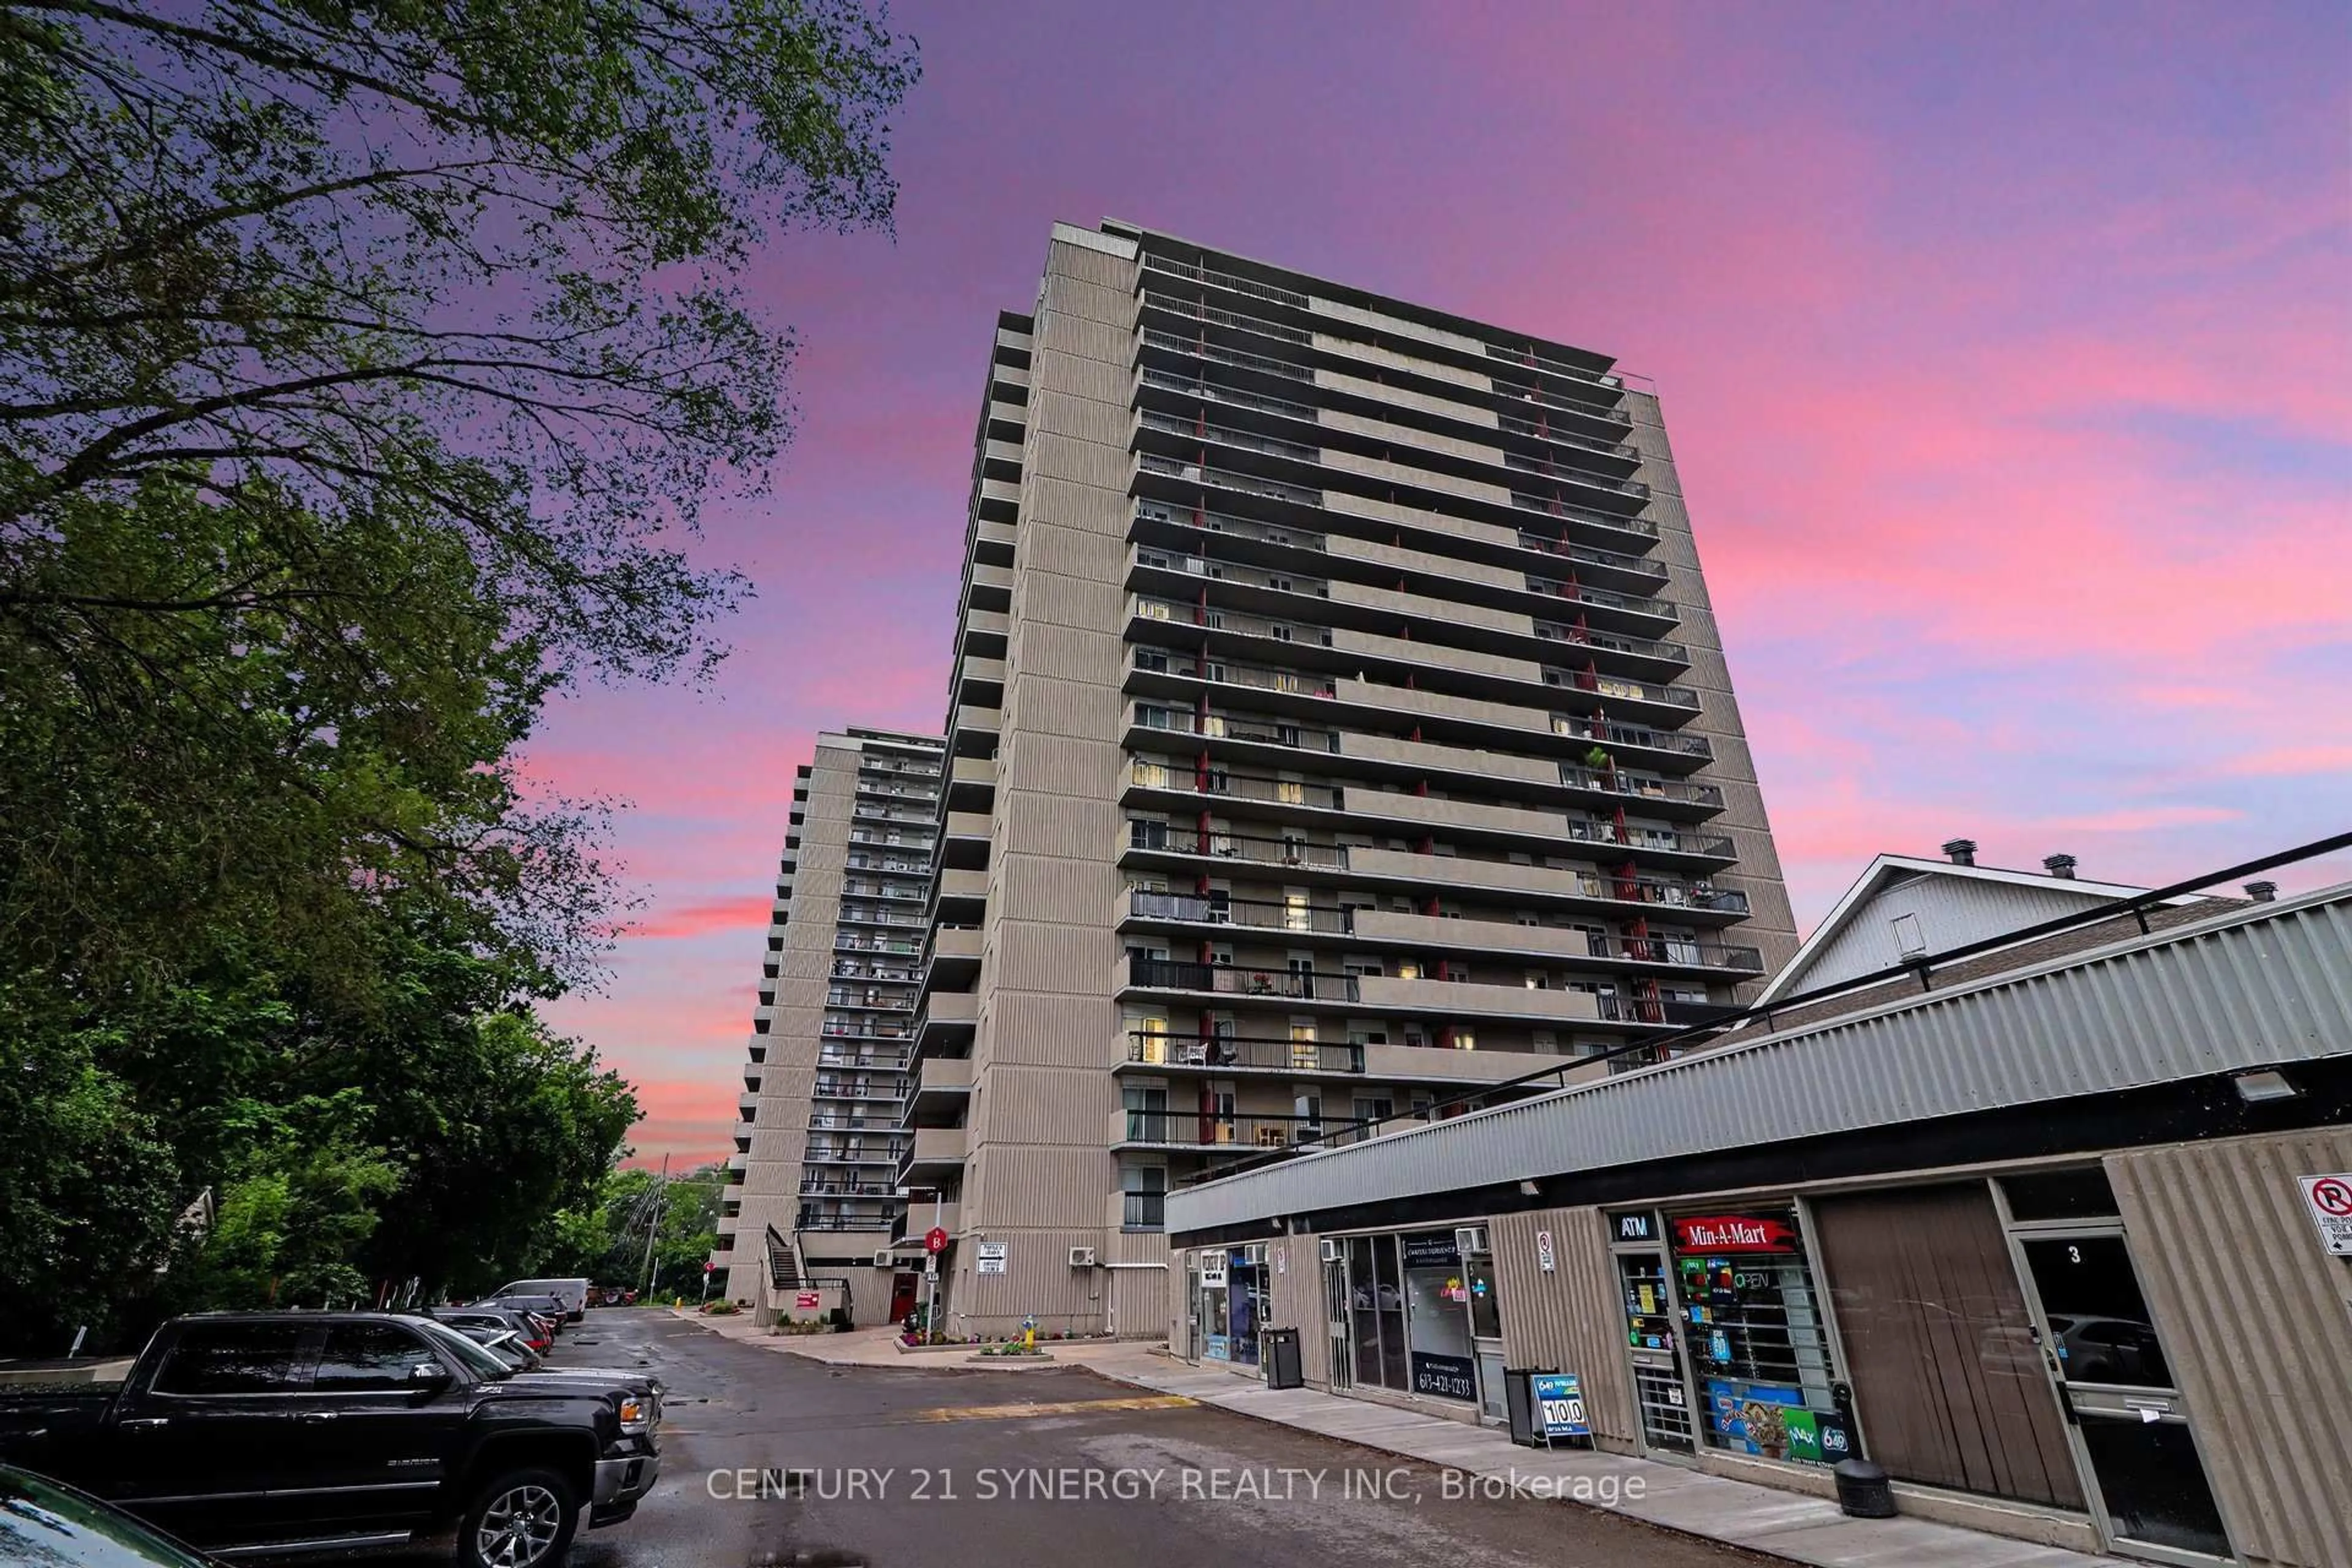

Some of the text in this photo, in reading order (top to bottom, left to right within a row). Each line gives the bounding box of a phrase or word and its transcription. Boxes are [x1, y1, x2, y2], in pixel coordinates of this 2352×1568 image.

[1621, 1216, 1648, 1236] ATM
[1689, 1222, 1767, 1246] Min-A-Mart
[2068, 1245, 2081, 1264] 3
[1734, 1272, 1769, 1289] OPEN
